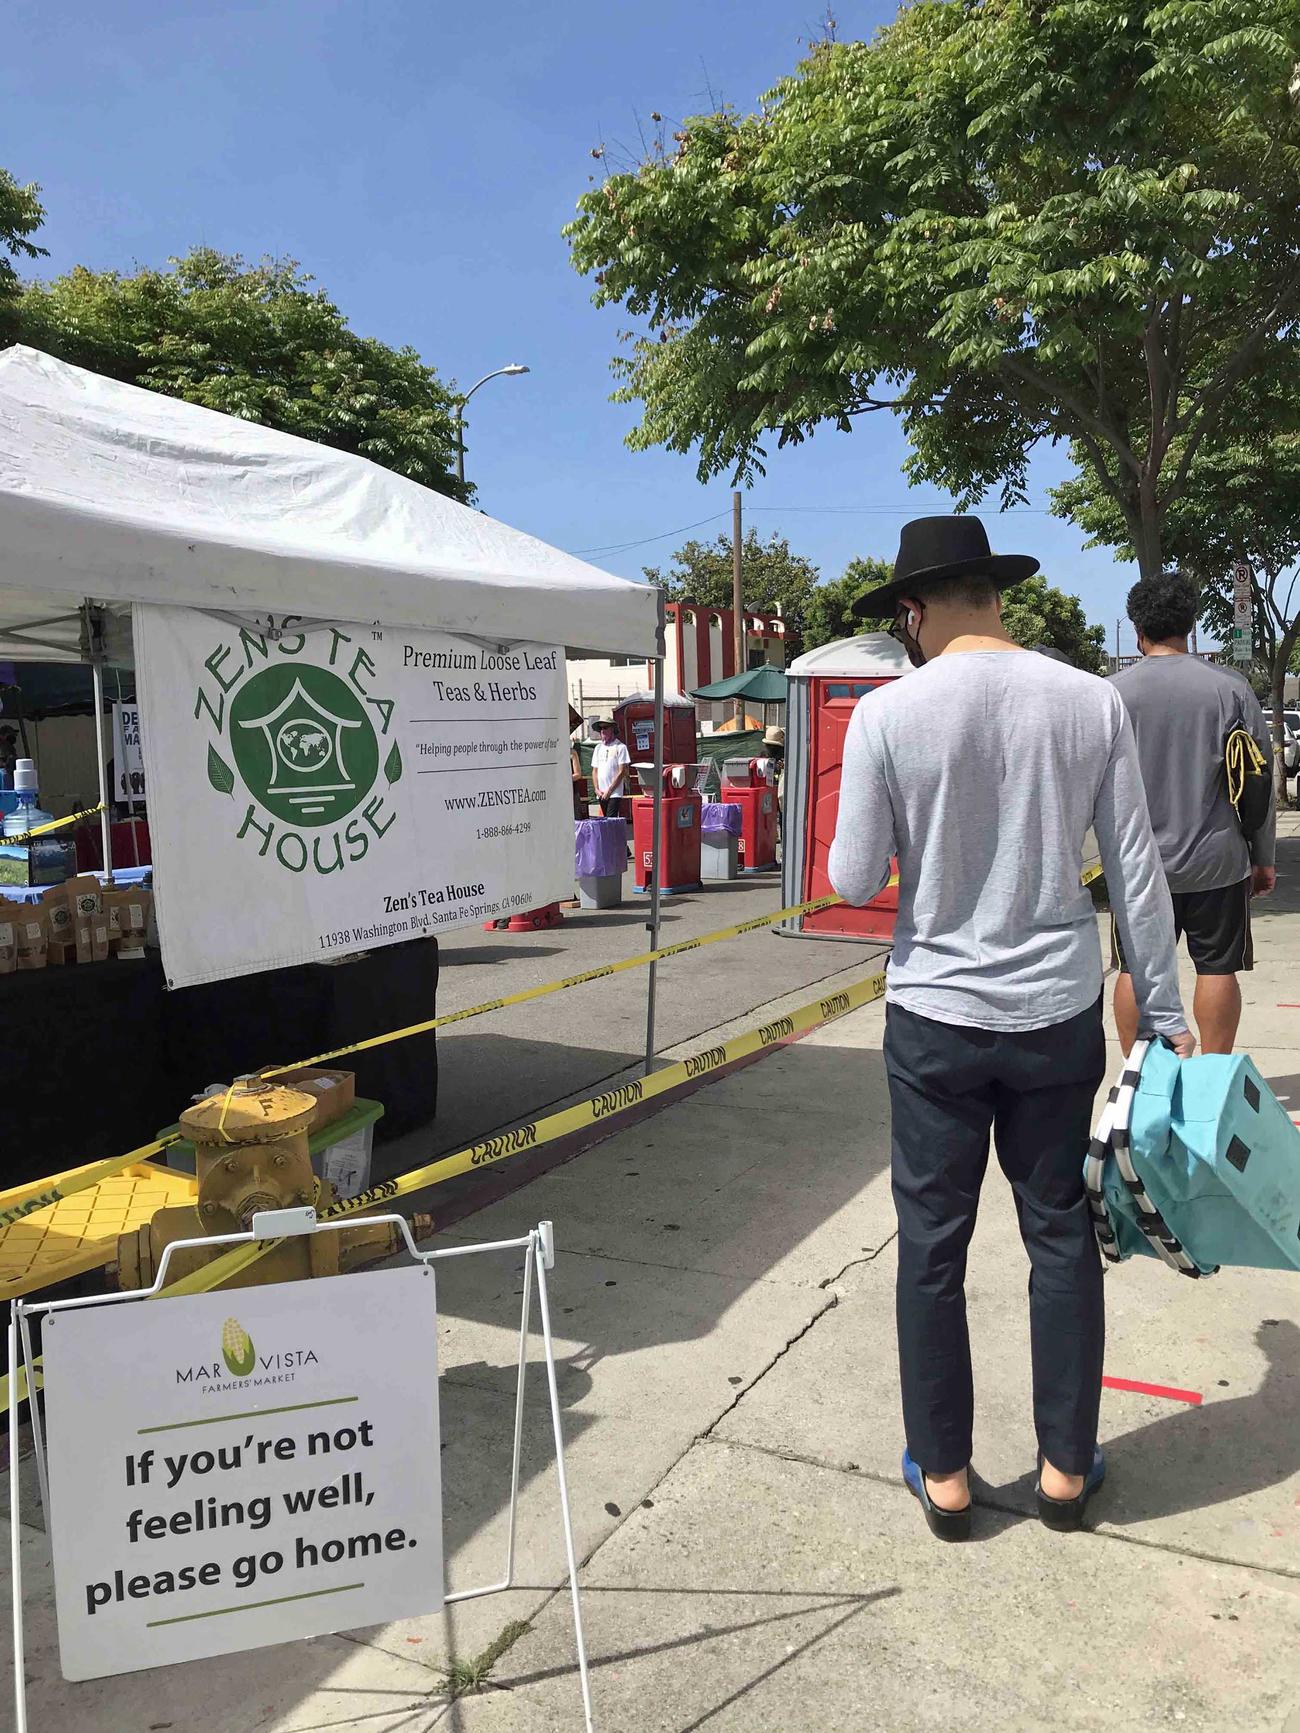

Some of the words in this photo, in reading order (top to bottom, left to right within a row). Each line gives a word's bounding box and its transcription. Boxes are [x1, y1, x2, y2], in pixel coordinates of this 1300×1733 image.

[403, 645, 477, 670] Premium
[480, 650, 521, 670] Loose
[523, 651, 557, 670] Leaf
[329, 627, 395, 734] TEA
[433, 681, 471, 701] Teas
[474, 682, 487, 701] &
[488, 681, 537, 702] Herbs
[416, 742, 452, 757] "Helping
[453, 741, 478, 756] people
[479, 741, 508, 755] through
[510, 740, 523, 751] the
[524, 739, 544, 752] power
[444, 788, 547, 811] www.ZENSTEA.com
[236, 795, 397, 874] HOUSE
[476, 822, 531, 840] 1-888-866-4299
[383, 891, 418, 913] Zen's
[419, 887, 444, 906] Tea
[445, 883, 485, 901] House
[319, 931, 351, 949] 11938
[352, 919, 408, 942] Washington
[410, 915, 432, 929] Blvd.
[432, 911, 458, 925] Santa
[459, 906, 469, 919] Fe
[502, 897, 510, 909] CA
[510, 891, 533, 906] 90606
[820, 992, 850, 1019] CAUTION
[758, 1017, 794, 1045] CAUTION
[684, 1046, 727, 1077] CAUTION
[591, 1081, 644, 1117] CAUTION
[471, 1124, 537, 1165] CAUTION
[176, 1363, 222, 1384] MAR
[259, 1350, 319, 1370] VISTA
[202, 1379, 252, 1394] FARMERS'
[253, 1373, 296, 1386] MARKET
[125, 1449, 155, 1486] If
[164, 1434, 296, 1489] you're
[307, 1420, 374, 1456] not
[125, 1497, 271, 1543] feeling
[282, 1472, 375, 1515] well,
[86, 1560, 221, 1615] please
[232, 1550, 284, 1588] go
[295, 1527, 417, 1569] home.
